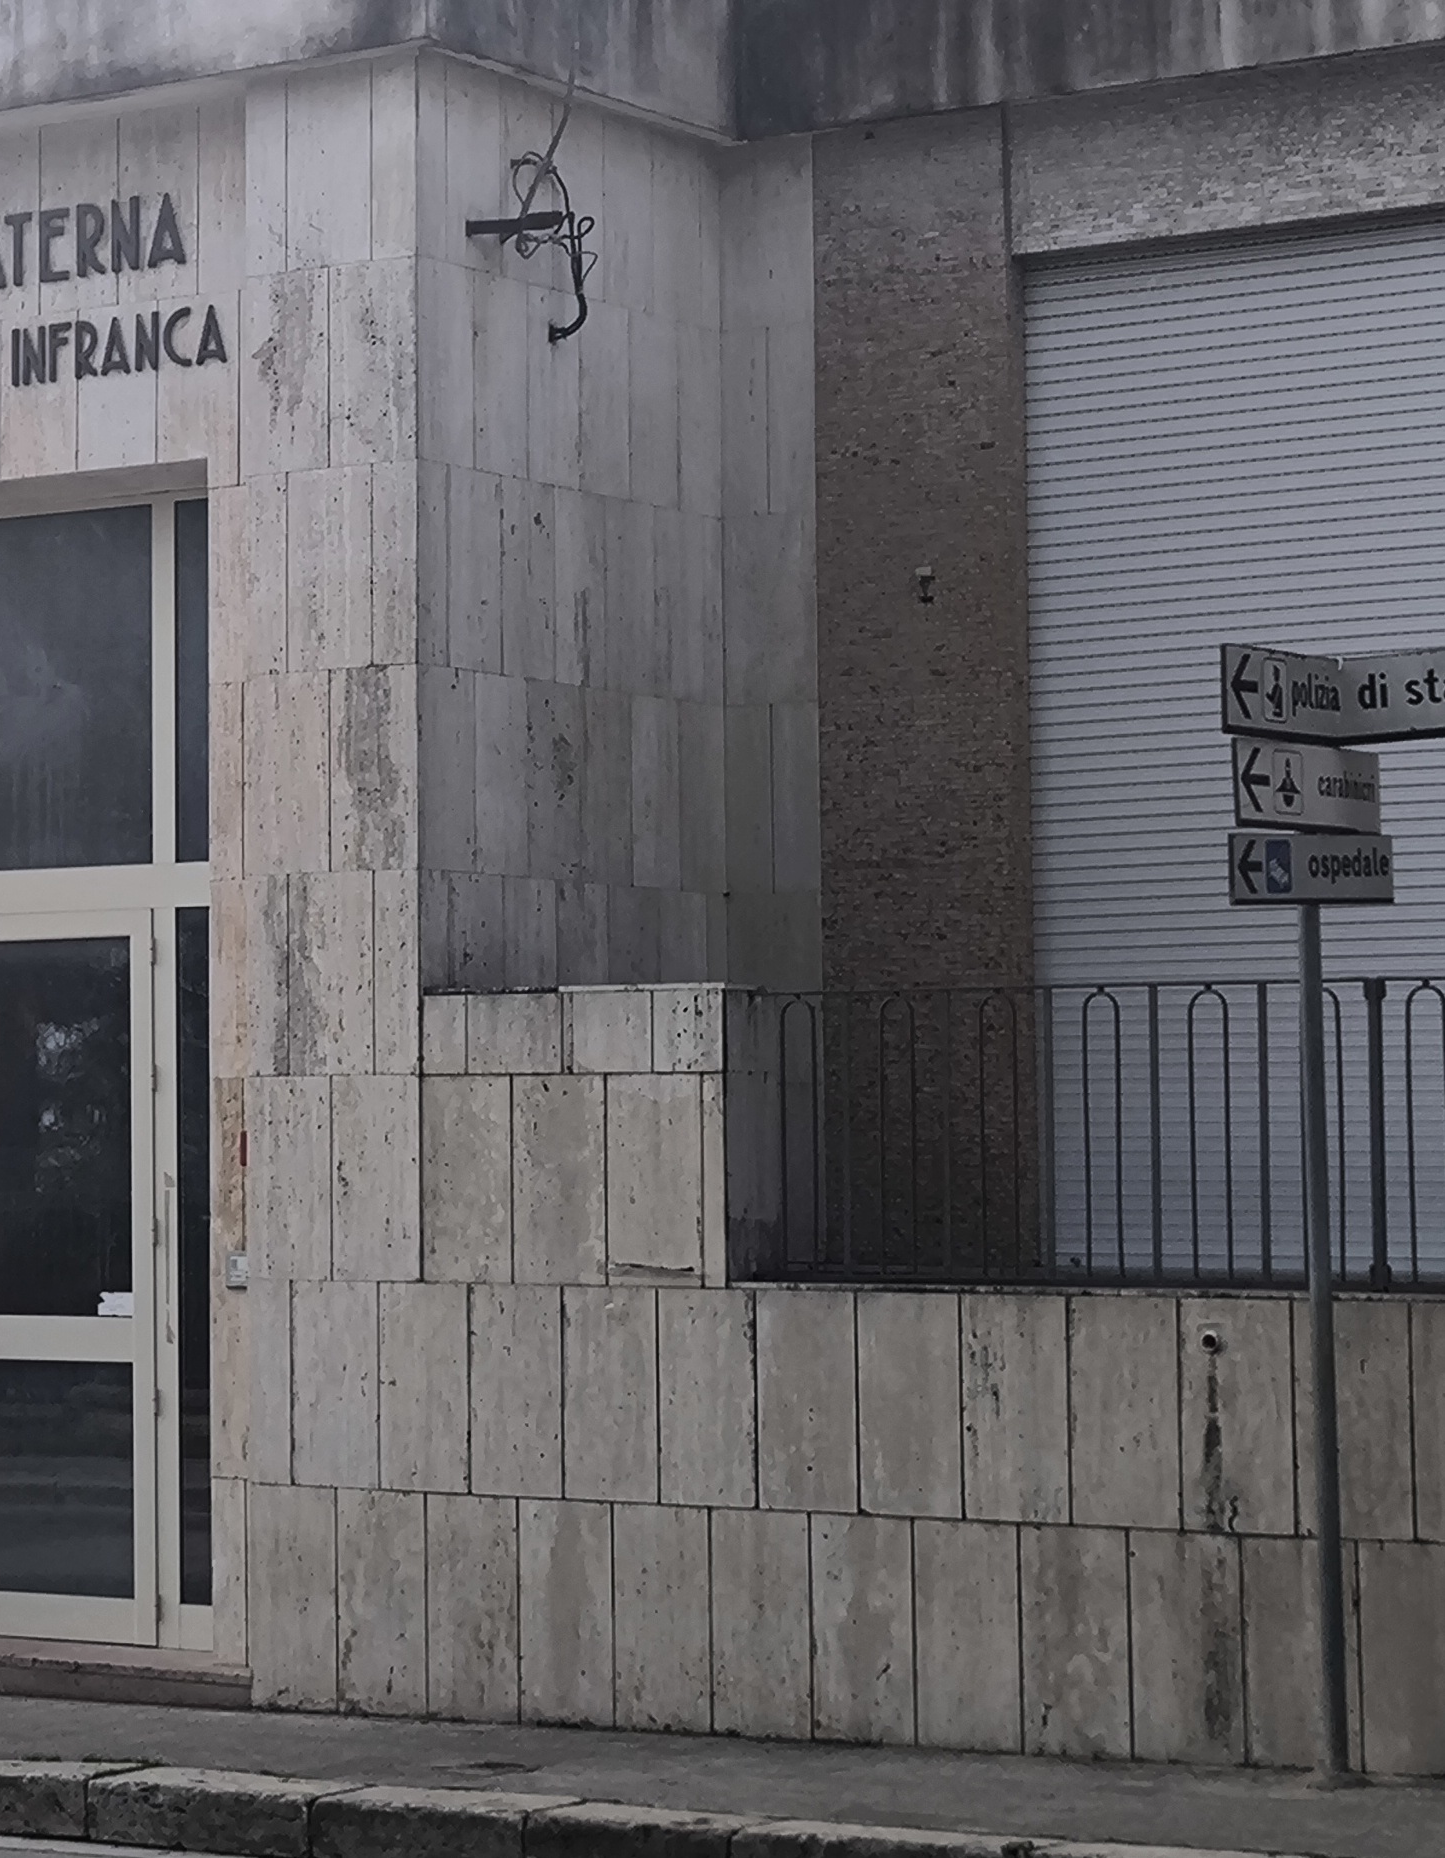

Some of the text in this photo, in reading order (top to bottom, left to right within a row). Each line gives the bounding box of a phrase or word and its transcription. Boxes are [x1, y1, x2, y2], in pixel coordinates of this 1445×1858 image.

[9, 303, 228, 388] INFRANCA
[1291, 668, 1445, 718] polizia di st
[1307, 847, 1390, 885] ospedale
